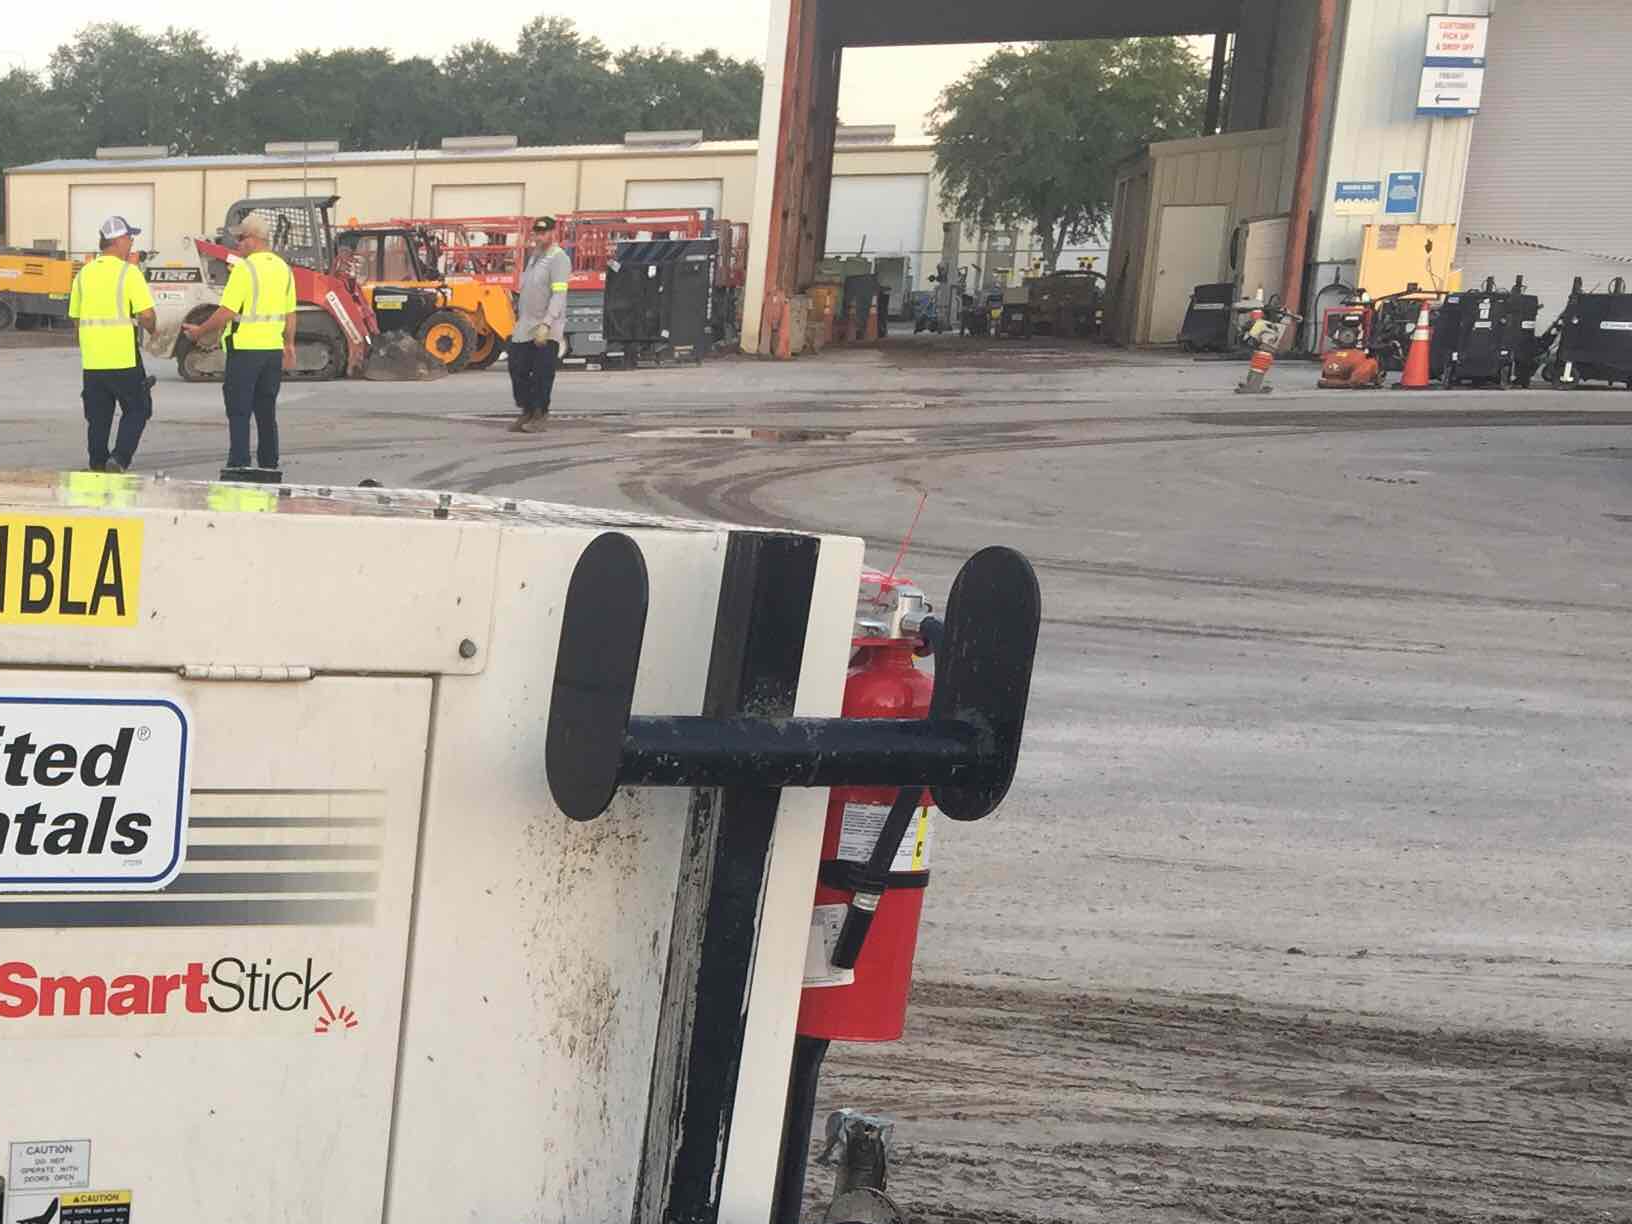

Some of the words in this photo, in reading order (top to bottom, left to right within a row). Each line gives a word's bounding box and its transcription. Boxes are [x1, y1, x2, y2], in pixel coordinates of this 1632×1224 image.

[26, 1145, 73, 1155] CAUTION
[20, 1167, 55, 1175] OPERATE
[24, 1175, 50, 1184] DOORS
[54, 1174, 75, 1182] OPEN
[80, 1193, 119, 1203] CAUTION
